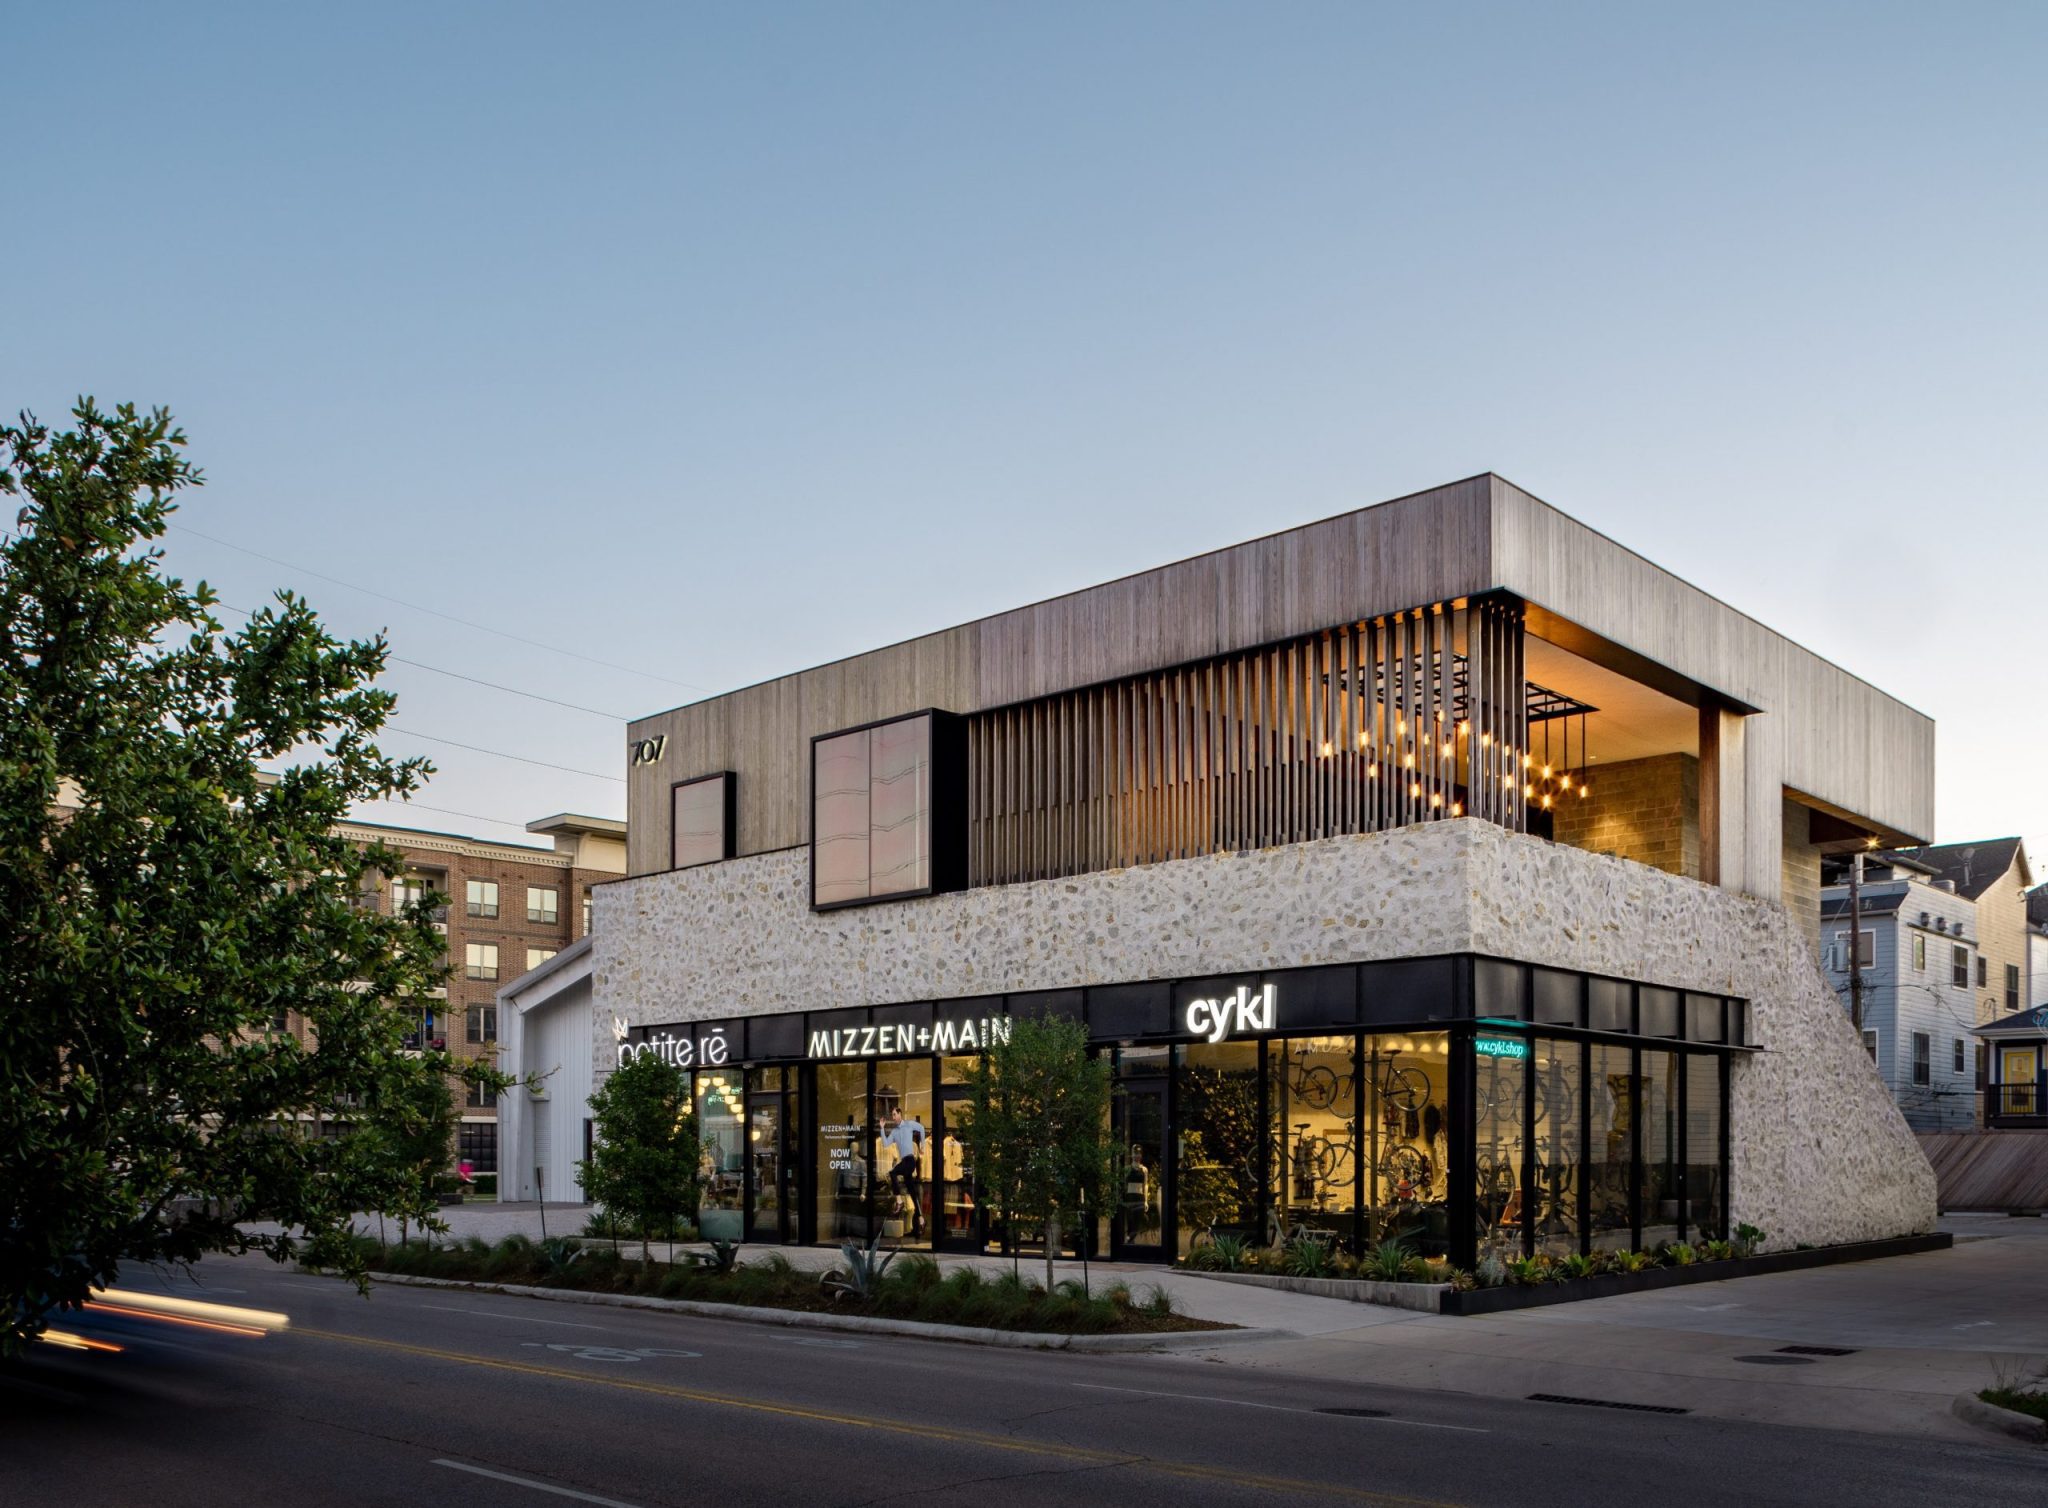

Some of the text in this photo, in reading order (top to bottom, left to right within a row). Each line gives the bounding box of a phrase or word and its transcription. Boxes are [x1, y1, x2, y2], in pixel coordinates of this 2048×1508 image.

[630, 735, 667, 767] 707
[1187, 984, 1277, 1043] cykl
[701, 1028, 728, 1065] rē
[809, 1016, 1012, 1058] MIZZEN+MAIN
[820, 1124, 861, 1132] MIZZEN+MAIN
[829, 1160, 851, 1170] OPEN
[830, 1148, 851, 1158] NOW
